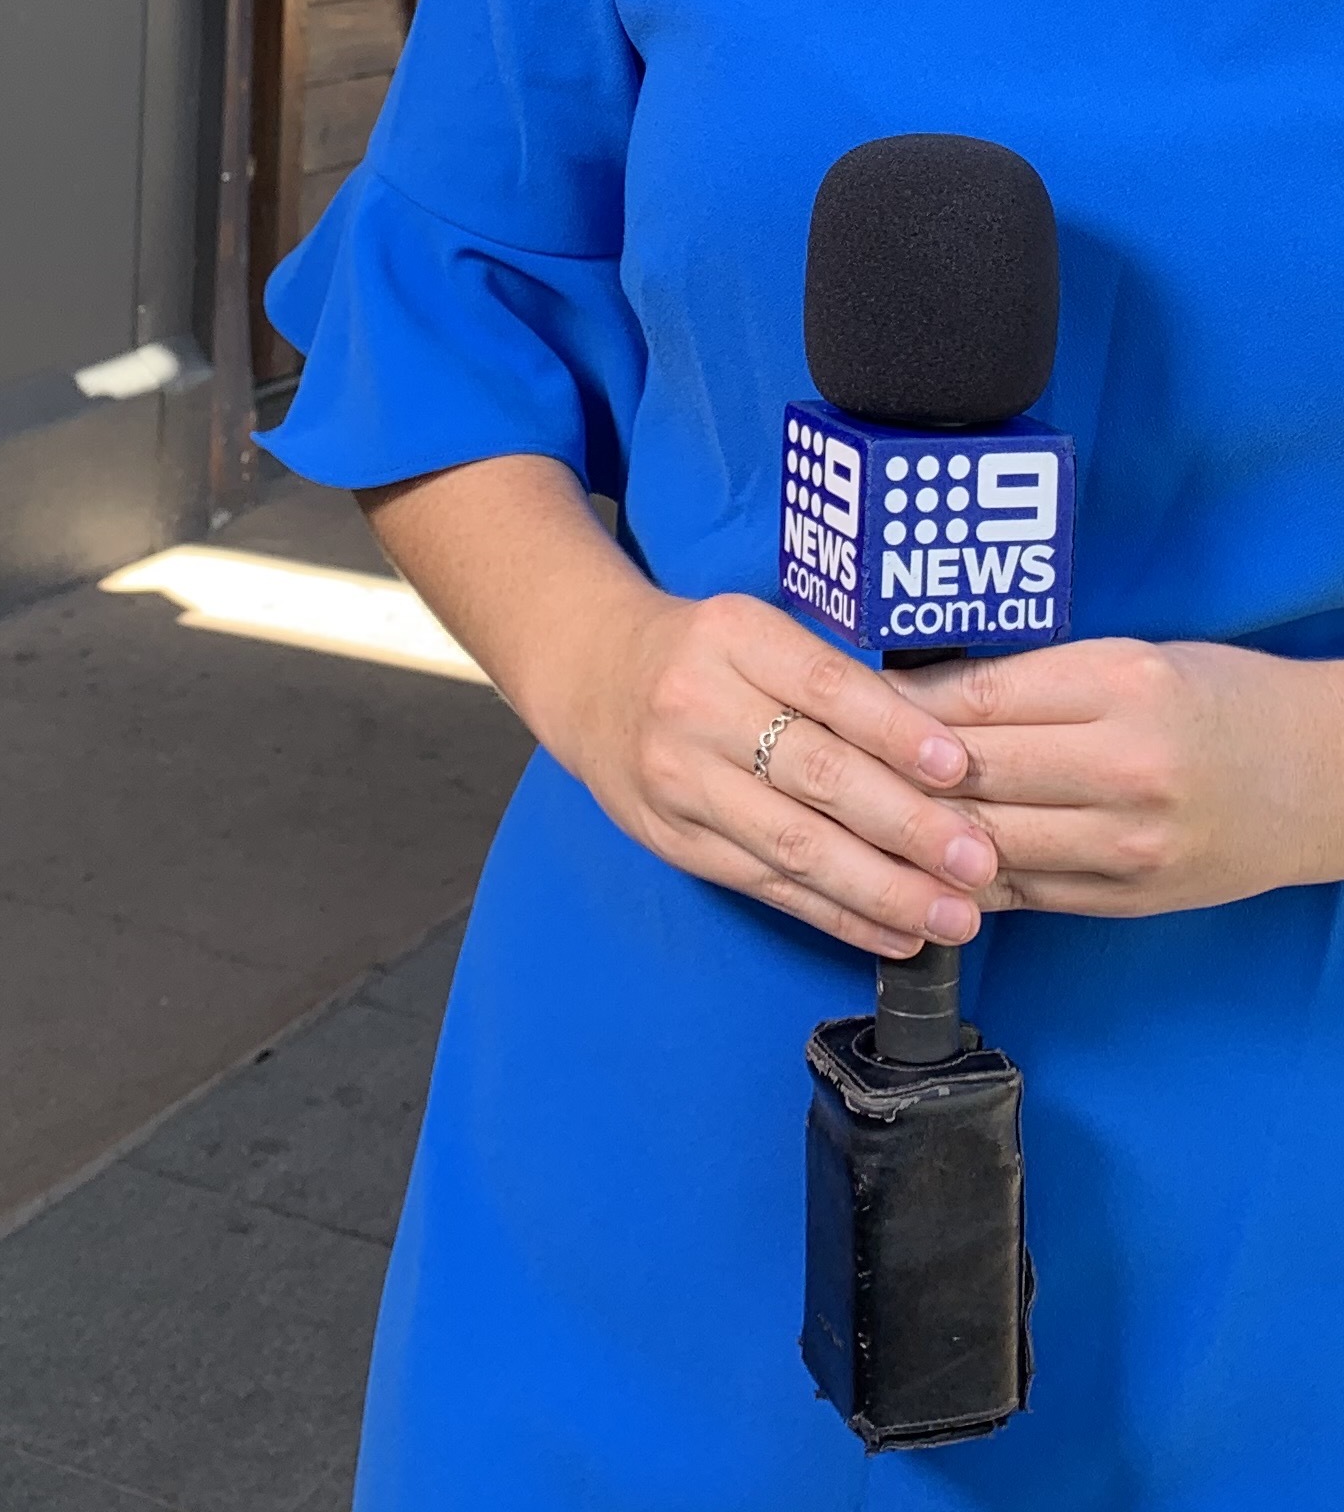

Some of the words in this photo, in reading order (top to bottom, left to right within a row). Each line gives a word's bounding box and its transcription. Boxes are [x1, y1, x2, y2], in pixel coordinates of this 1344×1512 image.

[823, 436, 861, 539] 9
[976, 451, 1059, 543] 9
[783, 506, 857, 591] NEWS
[880, 544, 1056, 599] NEWS
[782, 561, 856, 631] .com.au
[879, 597, 1055, 637] .com.au
